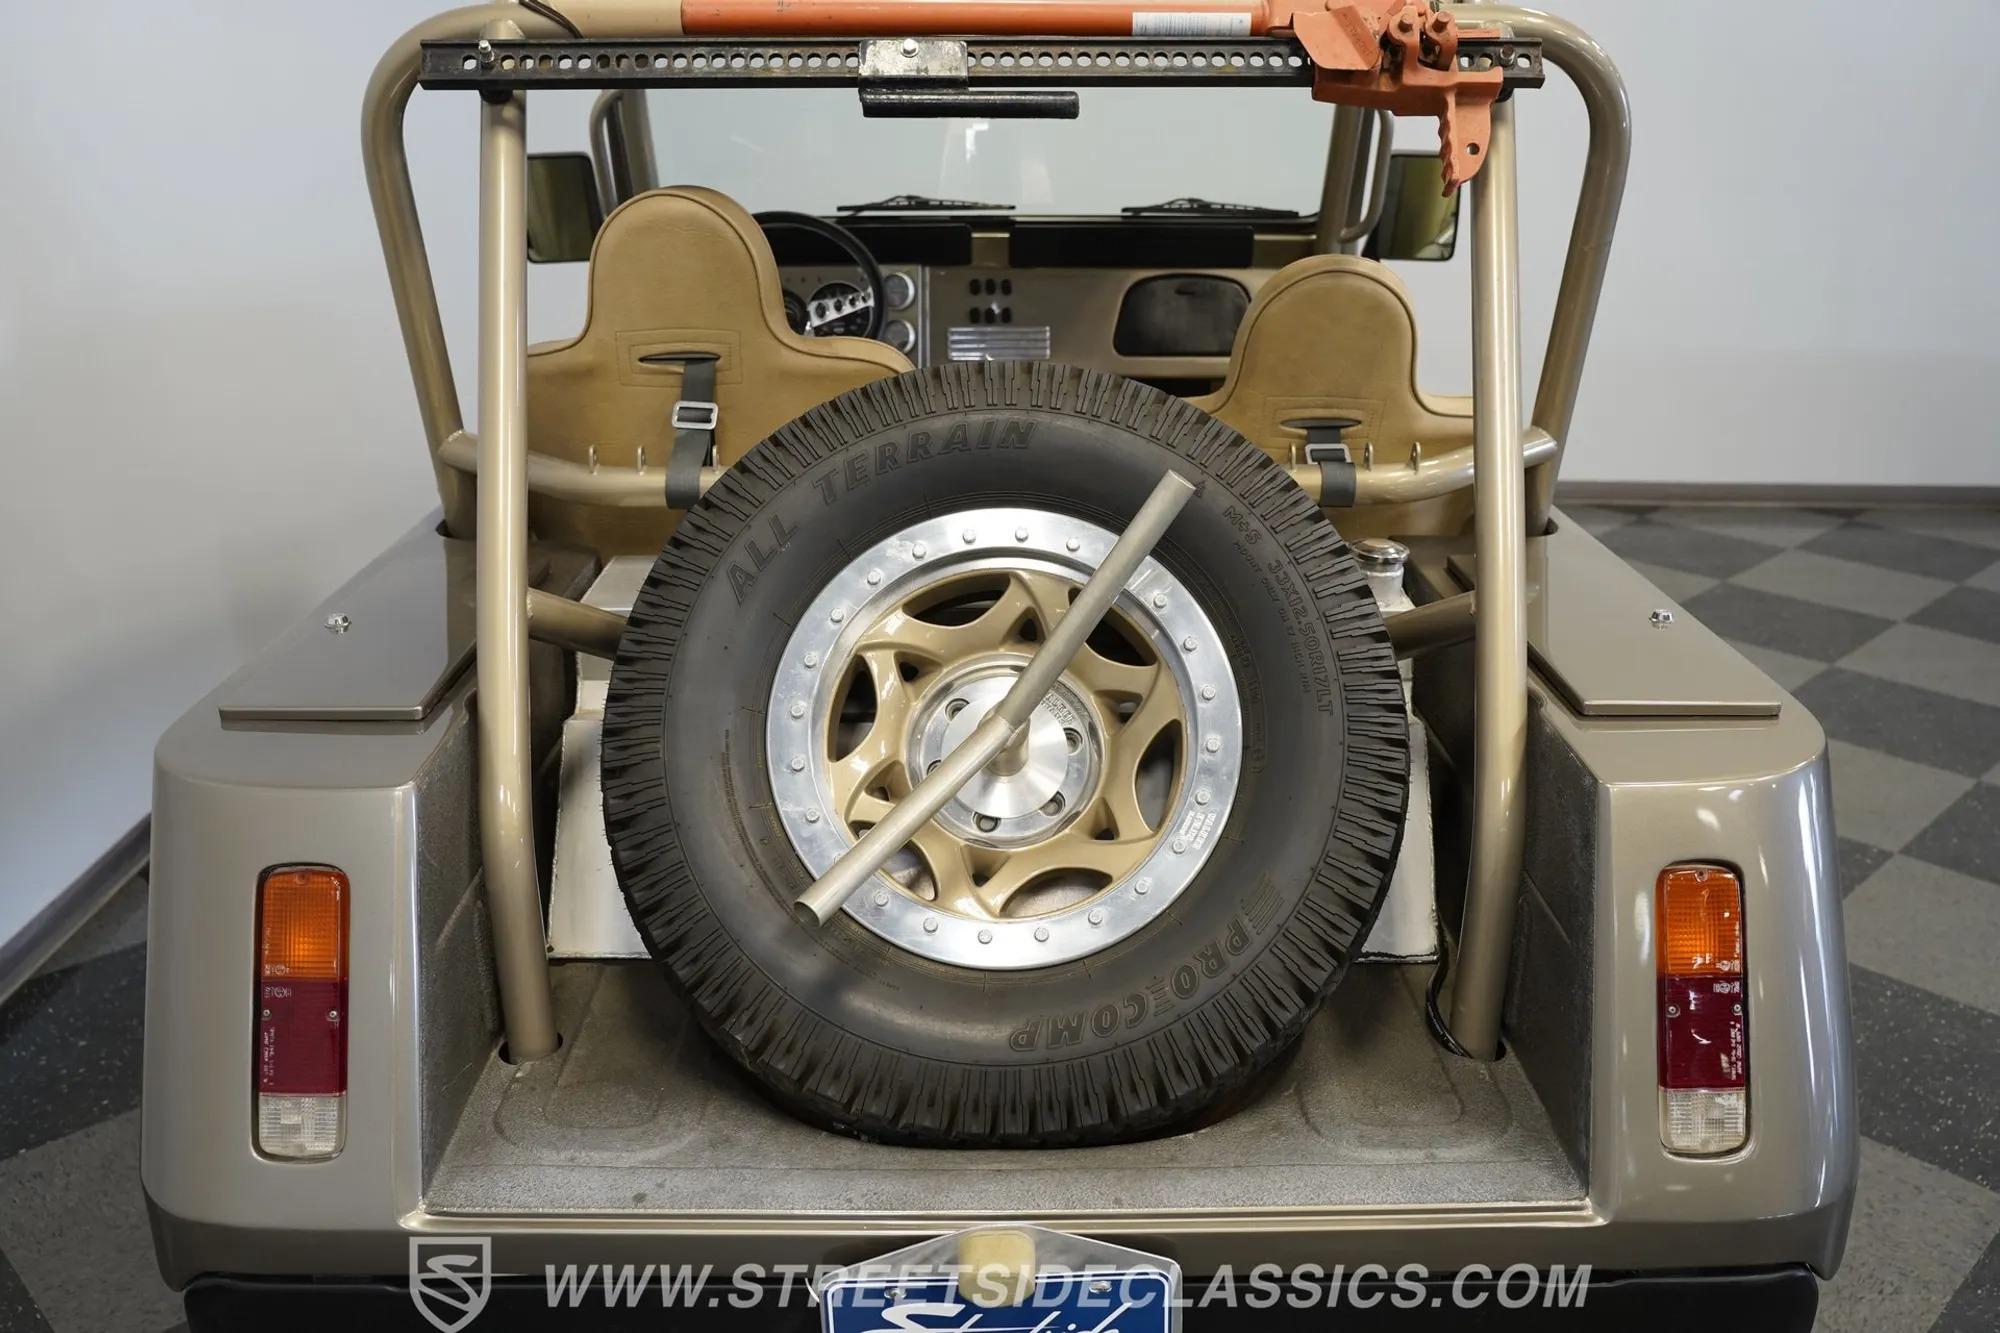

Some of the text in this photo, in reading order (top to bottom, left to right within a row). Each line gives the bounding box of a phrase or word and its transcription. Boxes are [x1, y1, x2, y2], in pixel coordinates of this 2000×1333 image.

[726, 418, 1039, 606] ALL TERRAIN
[1223, 504, 1262, 545] M+S
[1009, 917, 1252, 1051] PRO COMP
